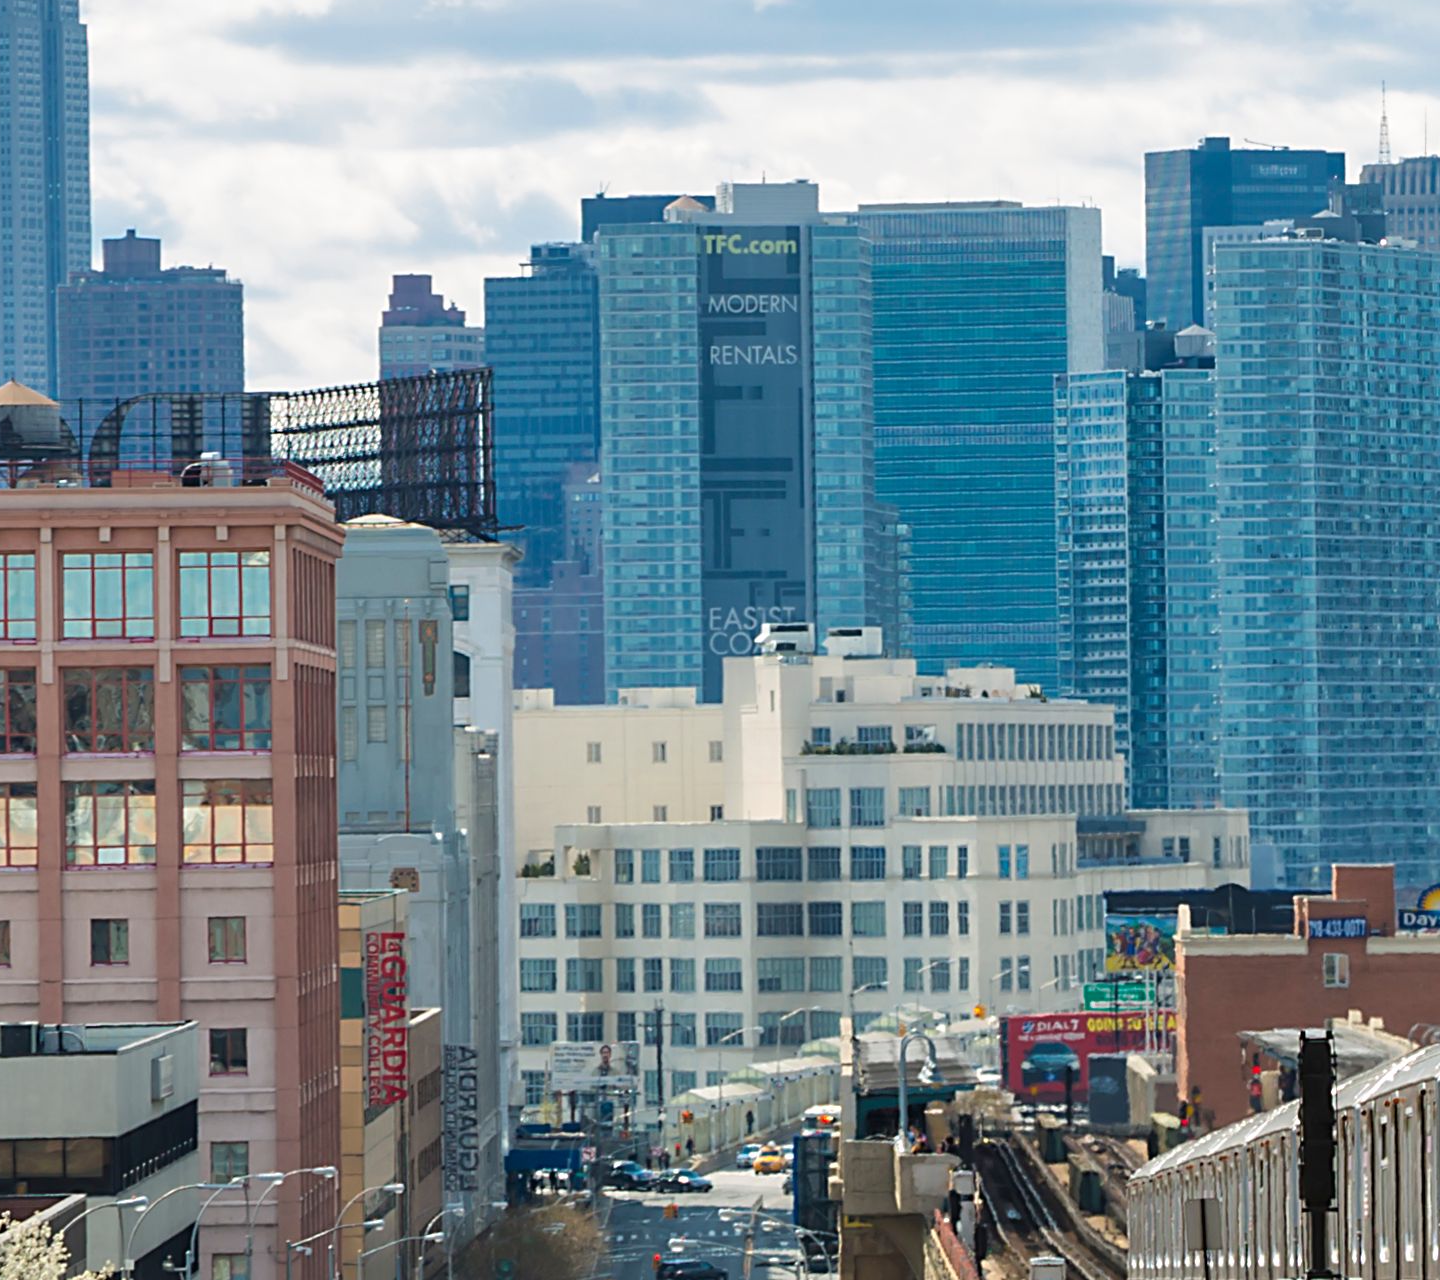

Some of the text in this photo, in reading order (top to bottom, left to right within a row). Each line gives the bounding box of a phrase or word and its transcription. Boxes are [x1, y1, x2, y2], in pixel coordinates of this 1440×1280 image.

[703, 234, 797, 254] TFC.com
[708, 294, 798, 314] MODERN
[709, 345, 798, 366] RENTALS
